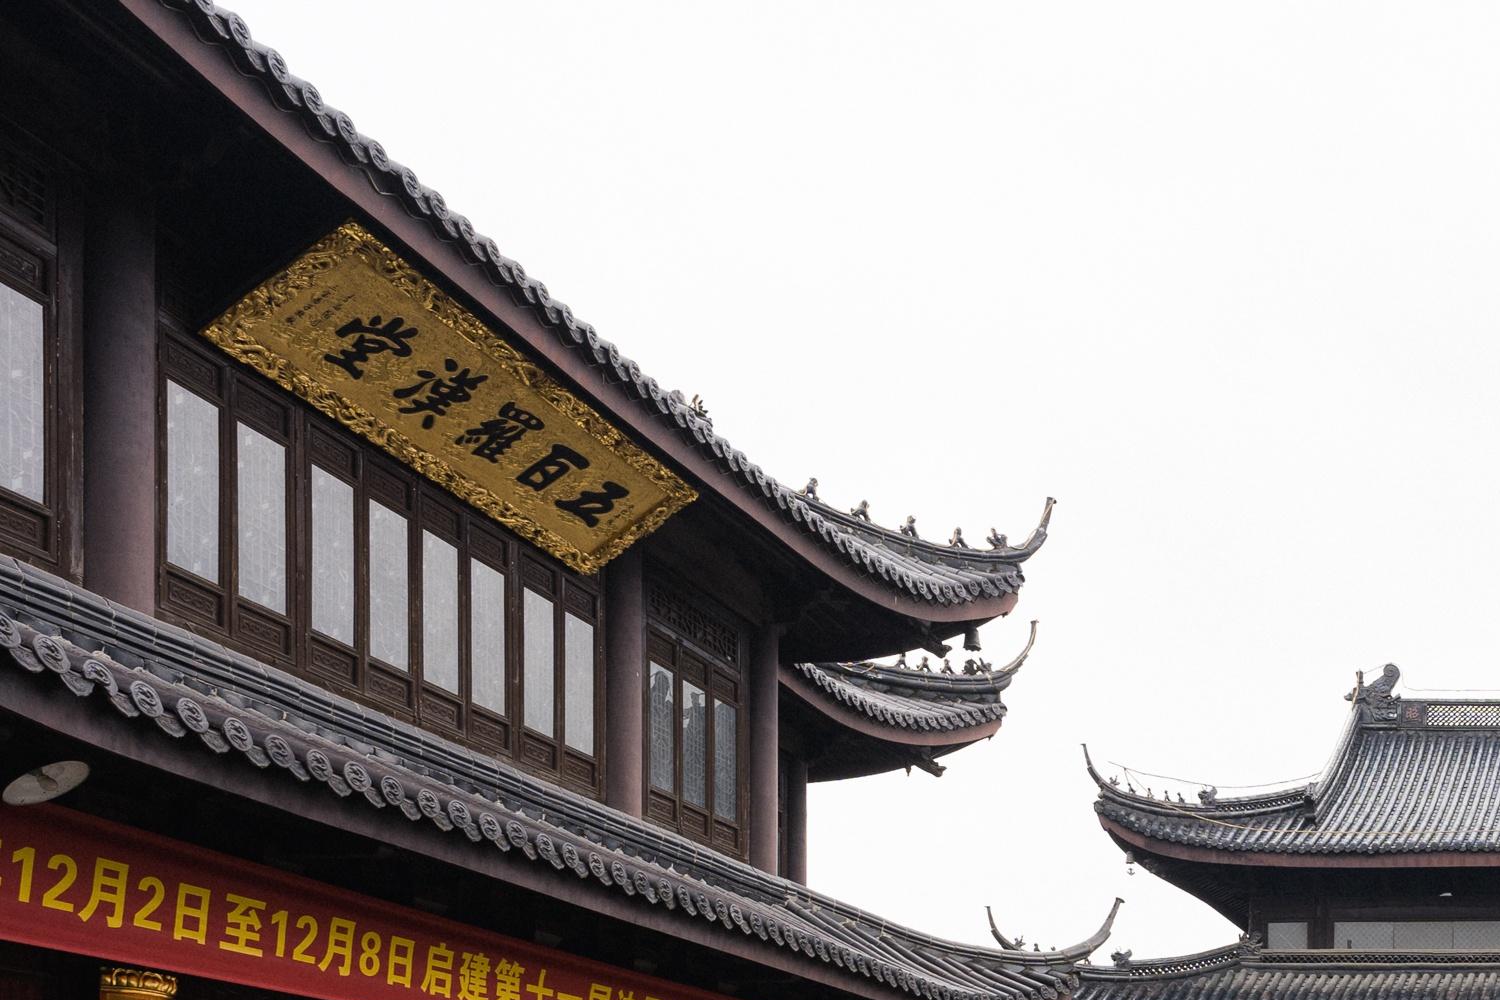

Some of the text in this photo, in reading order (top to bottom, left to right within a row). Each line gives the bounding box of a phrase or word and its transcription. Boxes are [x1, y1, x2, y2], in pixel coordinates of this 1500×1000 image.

[323, 313, 630, 528] 五百羅漢堂
